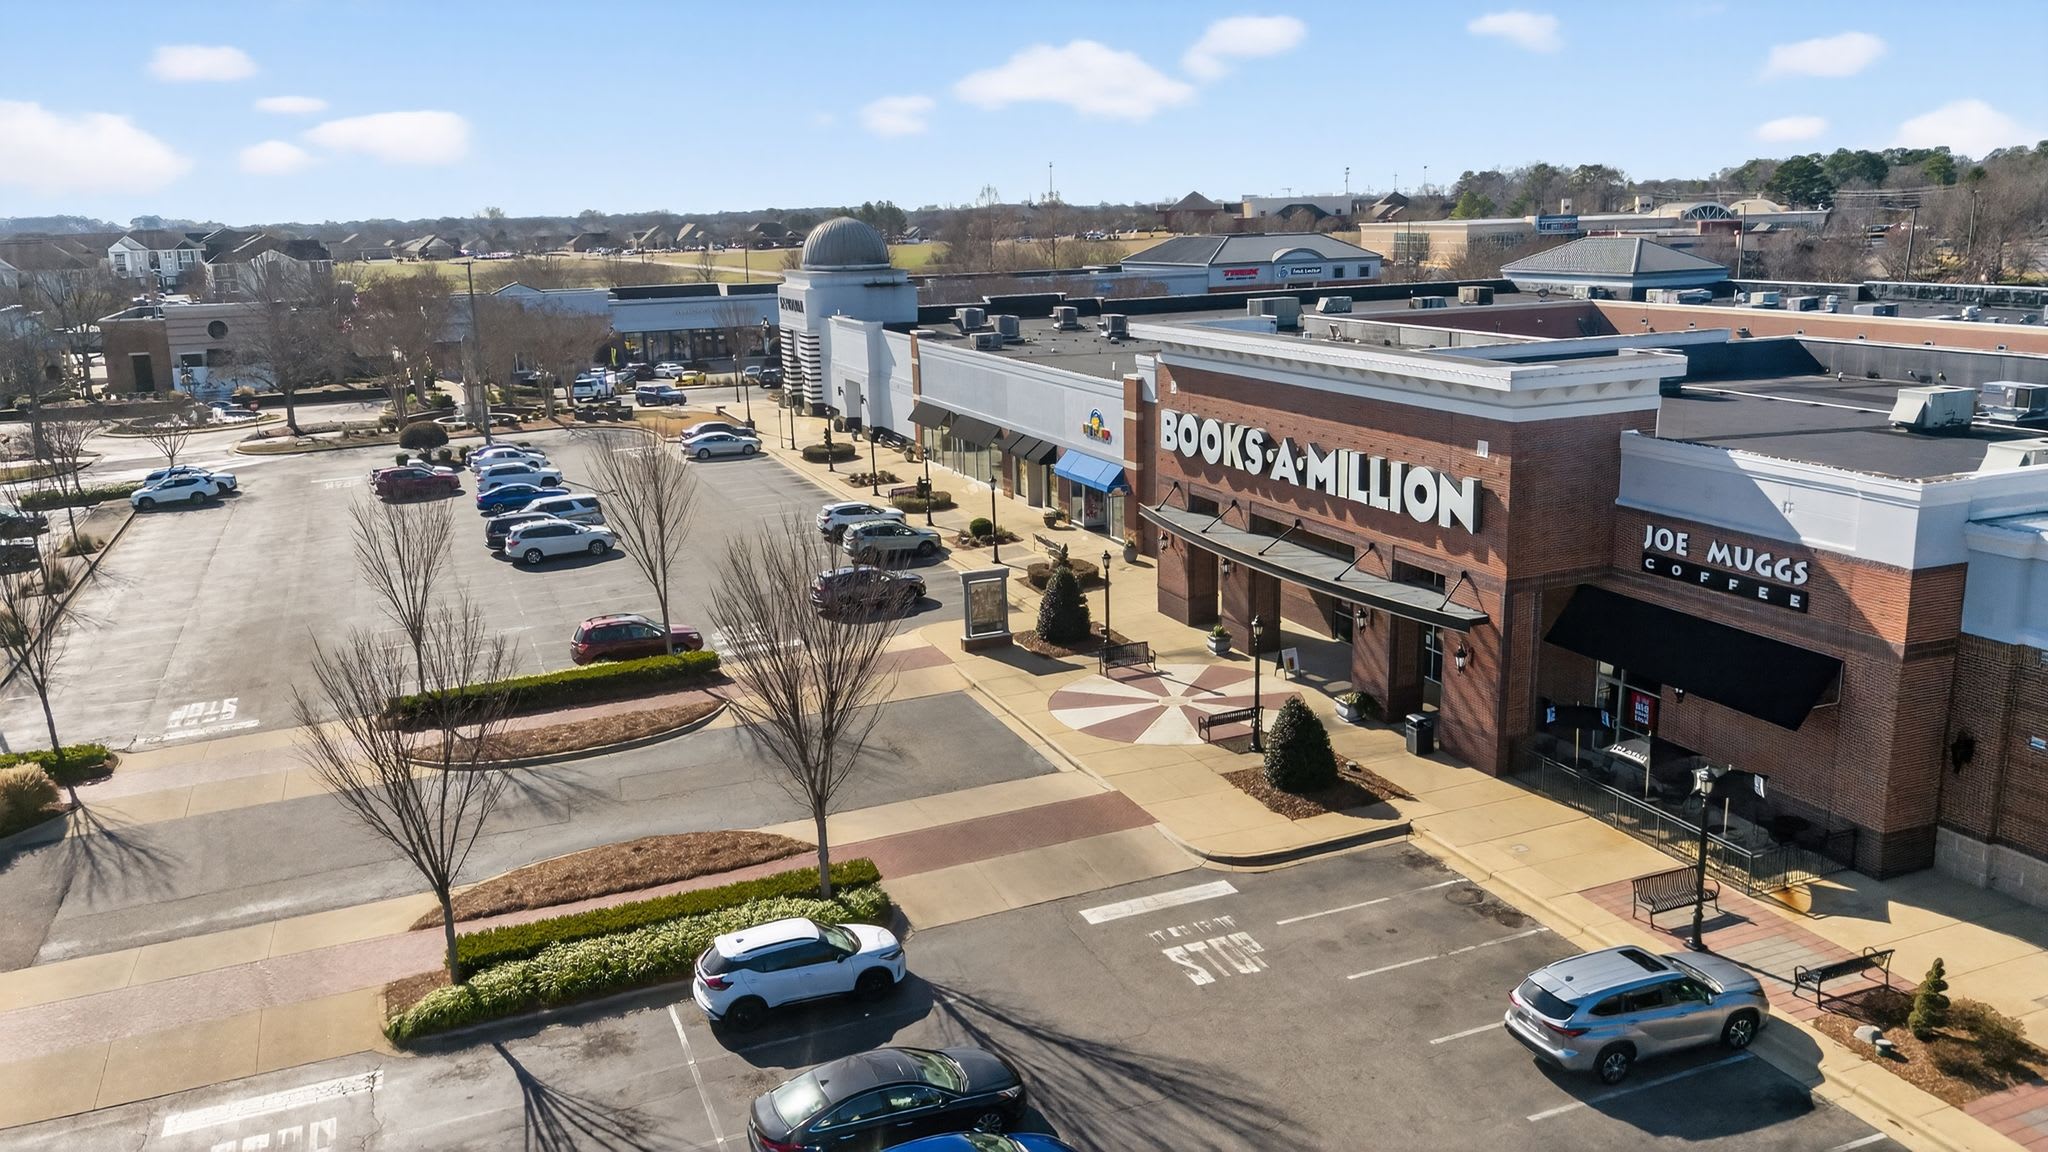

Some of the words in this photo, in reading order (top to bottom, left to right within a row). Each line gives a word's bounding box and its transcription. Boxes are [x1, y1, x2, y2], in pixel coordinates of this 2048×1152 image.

[1644, 525, 1689, 557] JOE
[1706, 539, 1809, 586] MUGGS
[1645, 558, 1801, 608] COFFEE
[1162, 931, 1270, 986] STOP
